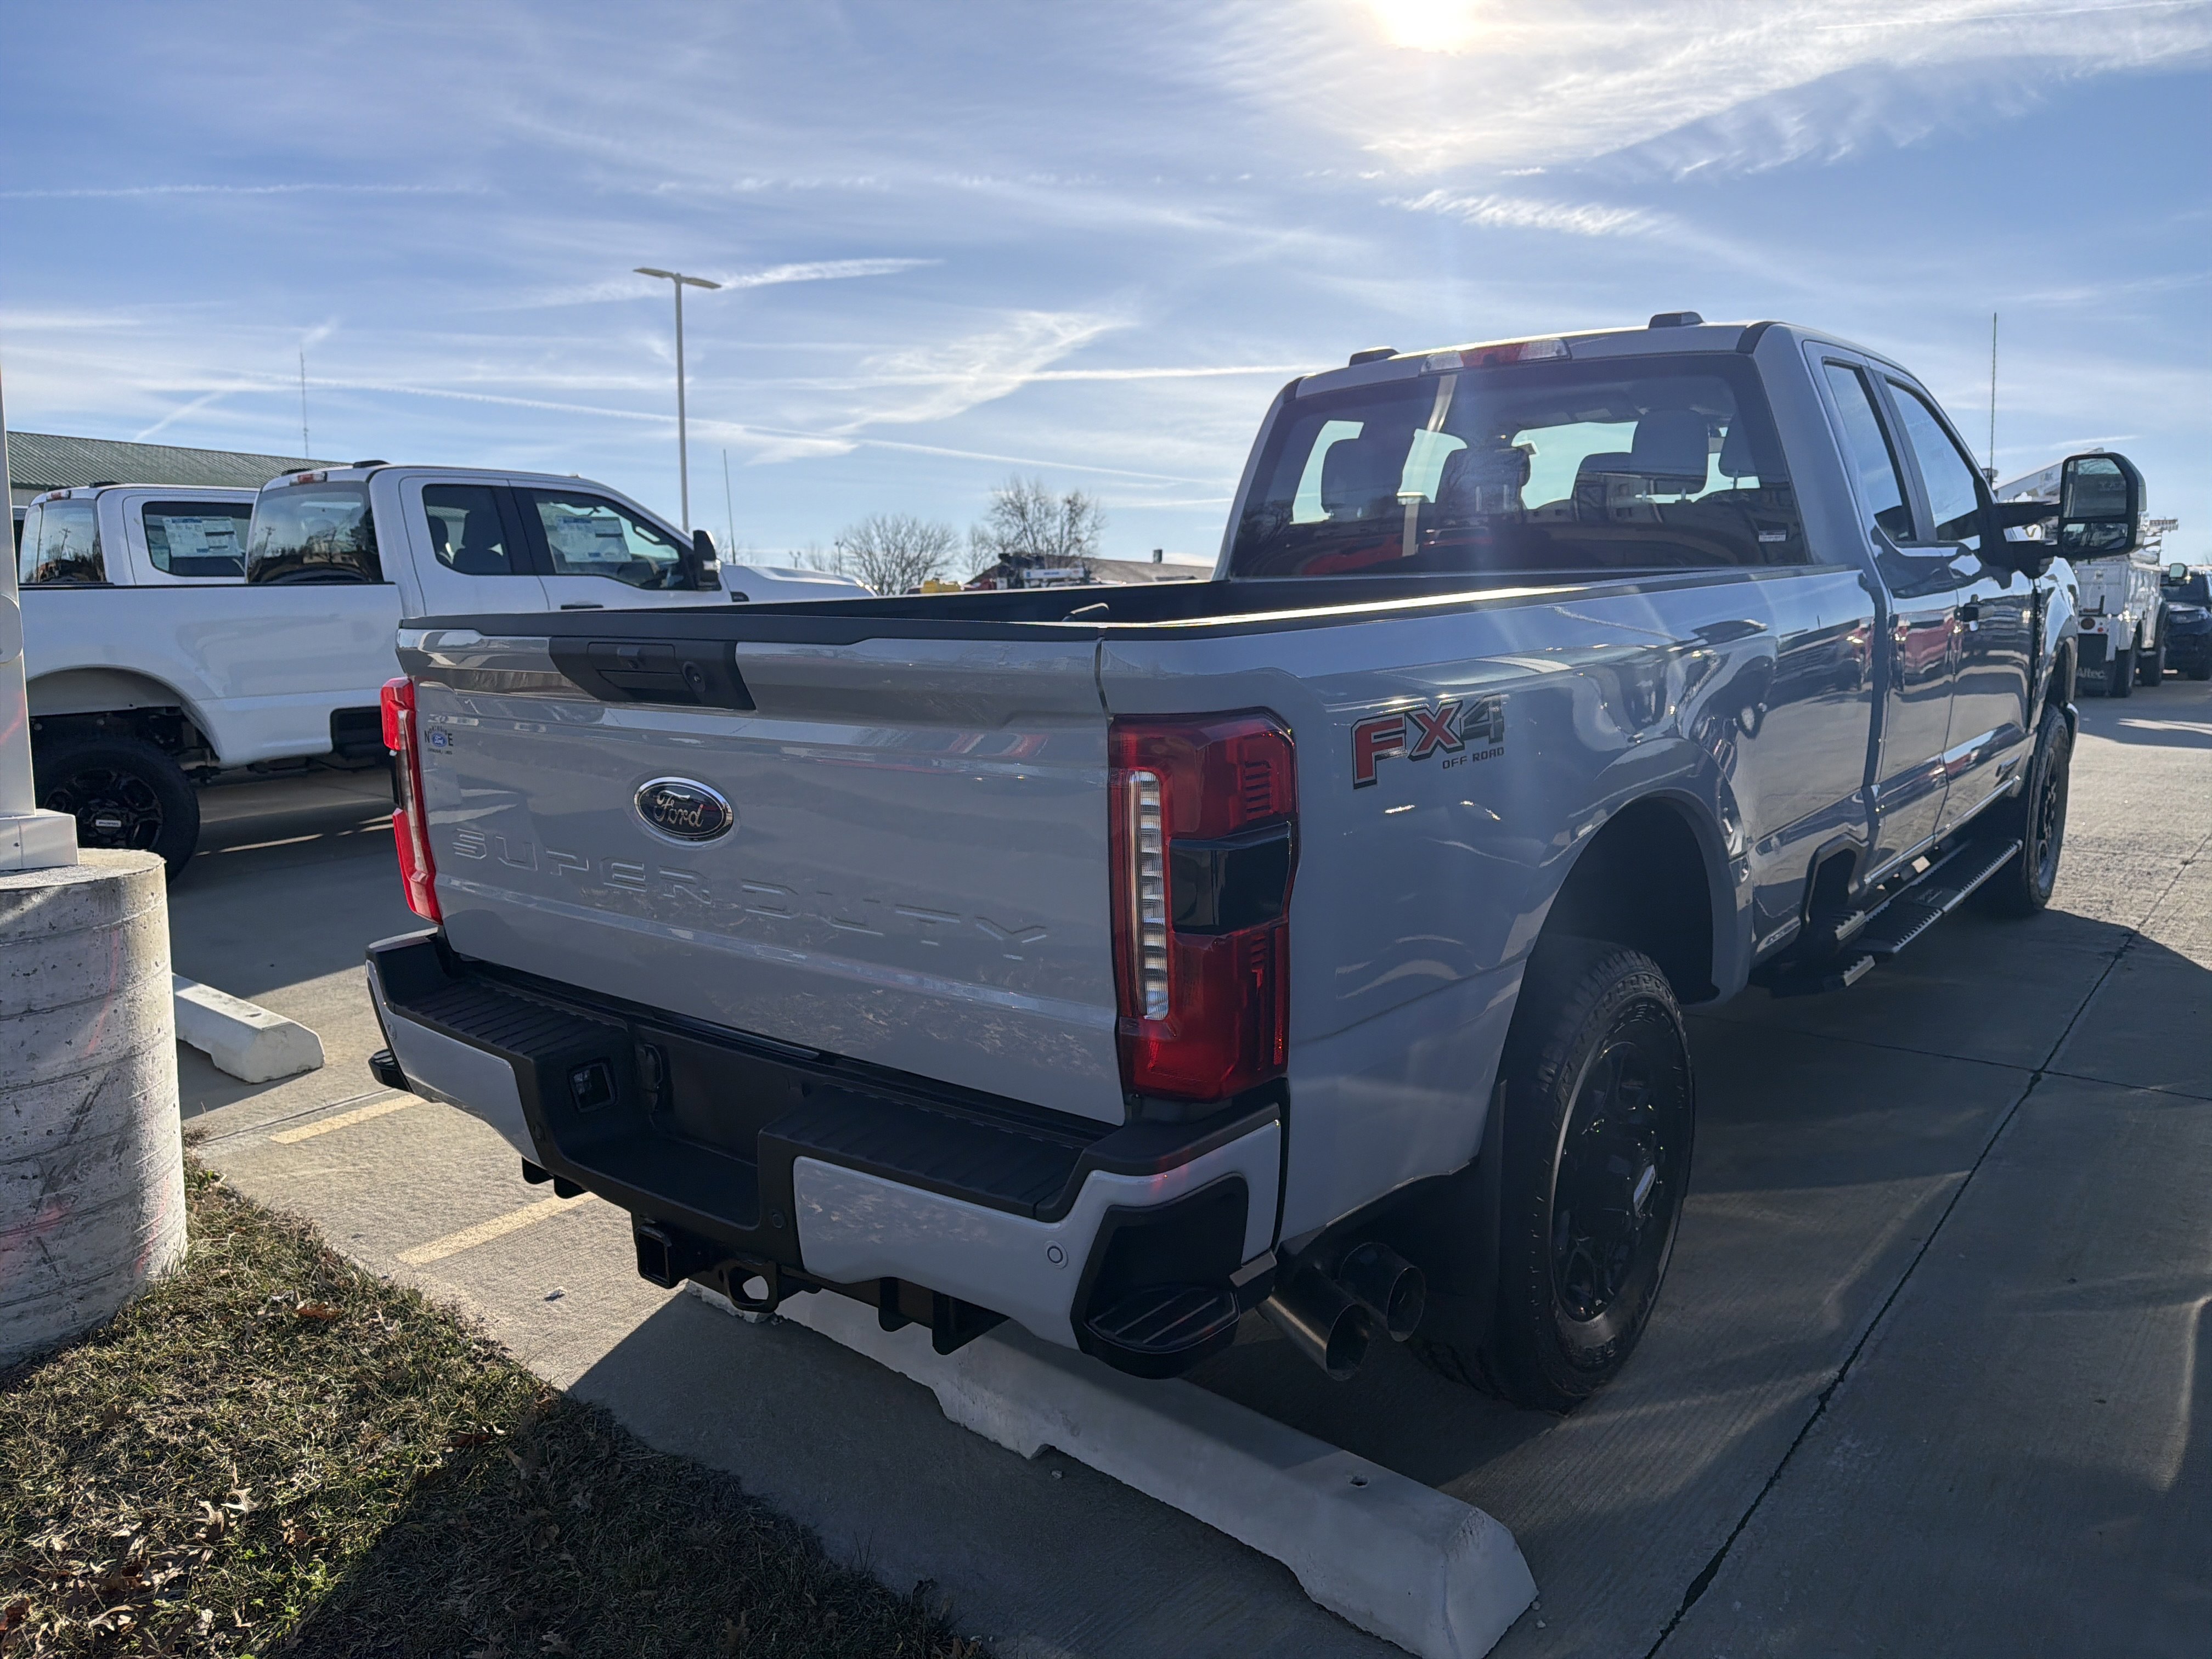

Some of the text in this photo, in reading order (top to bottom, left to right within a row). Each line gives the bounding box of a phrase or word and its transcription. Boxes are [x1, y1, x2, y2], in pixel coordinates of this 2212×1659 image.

[1351, 693, 1505, 790] FX4
[1442, 746, 1505, 769] OFF ROAD
[652, 788, 704, 828] Ford
[452, 827, 1047, 961] SUPER DUTY
